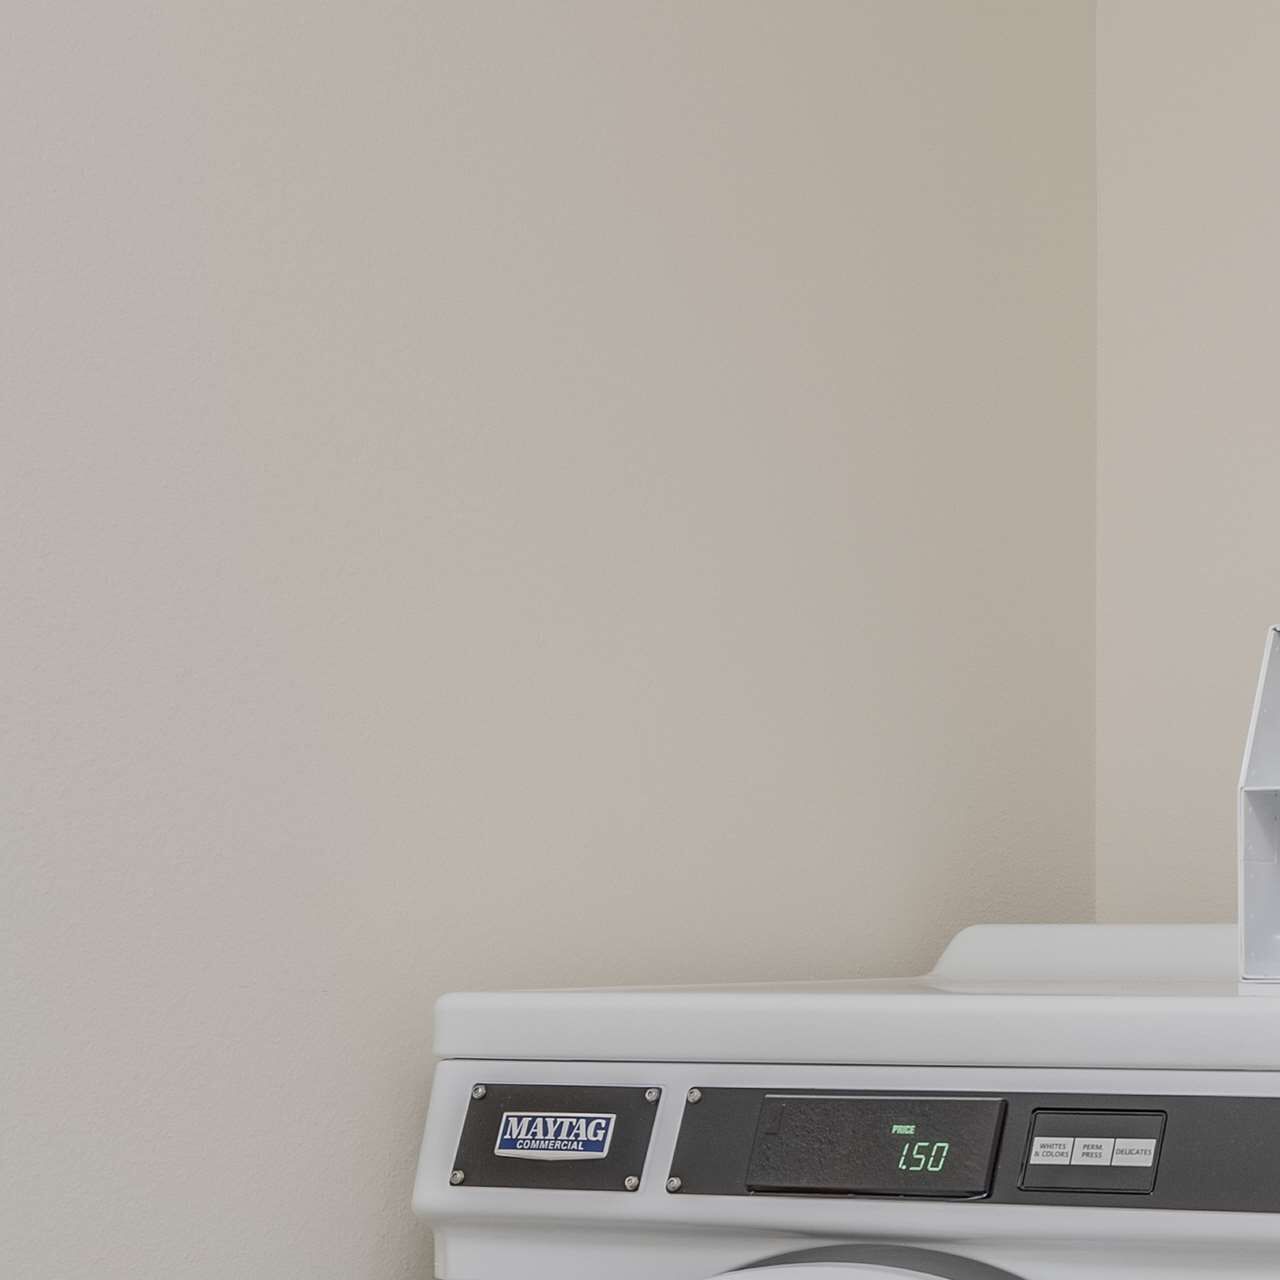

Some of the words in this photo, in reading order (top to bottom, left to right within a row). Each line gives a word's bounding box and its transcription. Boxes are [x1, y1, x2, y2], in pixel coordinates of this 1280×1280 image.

[504, 1116, 607, 1141] MAYTAG
[891, 1125, 916, 1135] PRICE
[516, 1139, 585, 1151] COMMERCIAL
[898, 1142, 950, 1172] 1.50
[1081, 1151, 1103, 1159] PRESS
[1115, 1148, 1152, 1156] DELICATES
